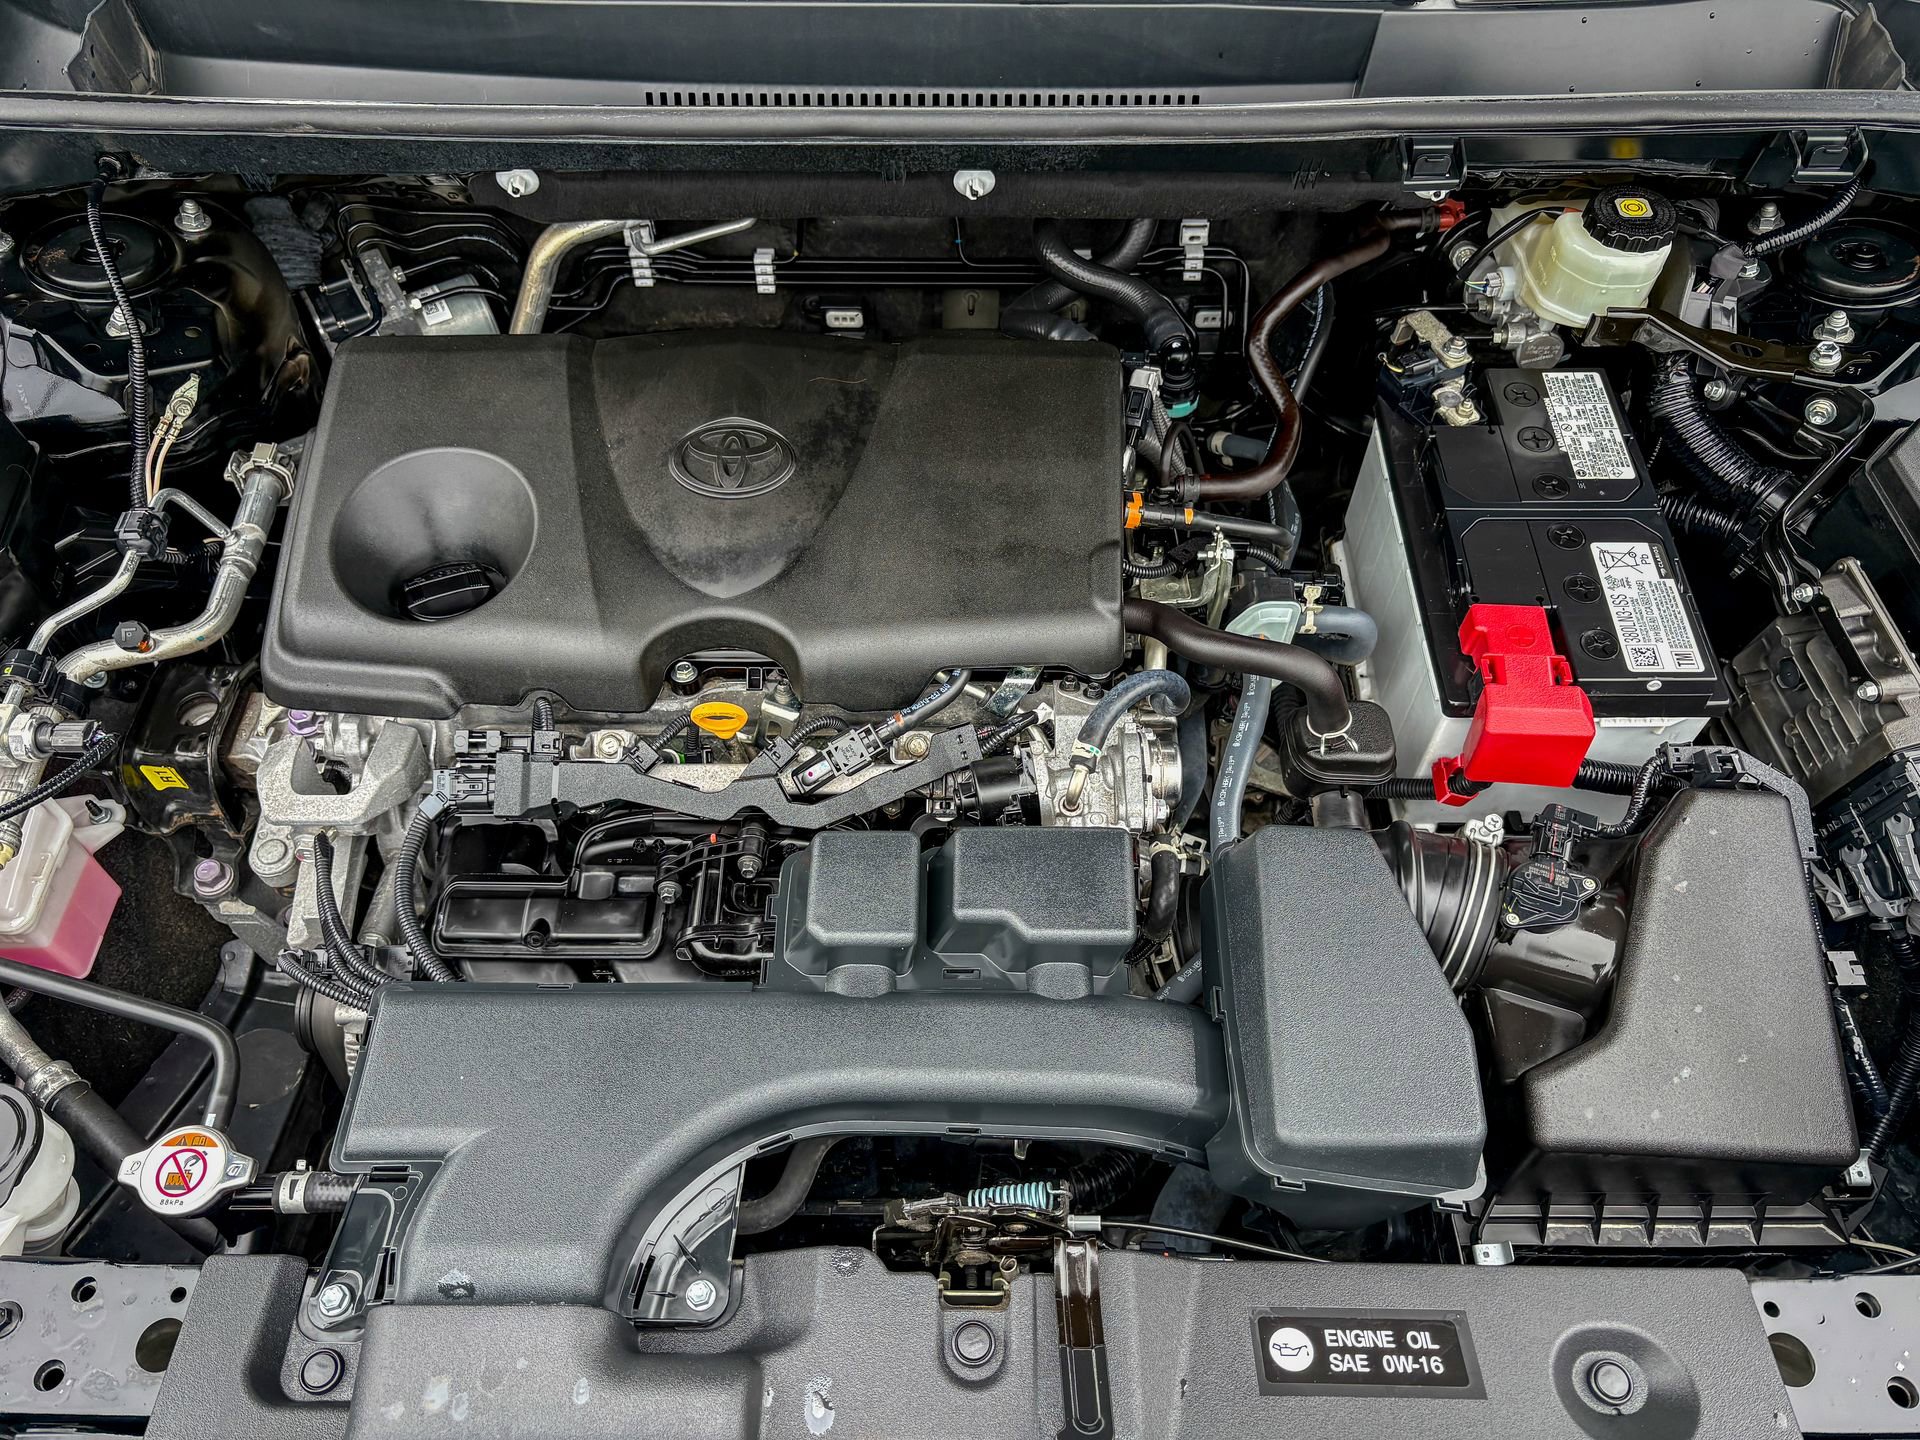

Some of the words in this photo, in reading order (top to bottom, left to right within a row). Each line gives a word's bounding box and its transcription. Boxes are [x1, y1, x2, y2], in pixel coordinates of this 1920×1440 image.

[1640, 553, 1651, 564] Pb
[1652, 546, 1663, 567] CLARIOS
[1610, 594, 1640, 643] 380LN3-ISS
[1674, 653, 1696, 667] TM
[1324, 1329, 1396, 1348] ENGINE
[1406, 1331, 1440, 1349] OIL
[1329, 1354, 1371, 1372] SAE
[1382, 1356, 1444, 1374] 0W-16
